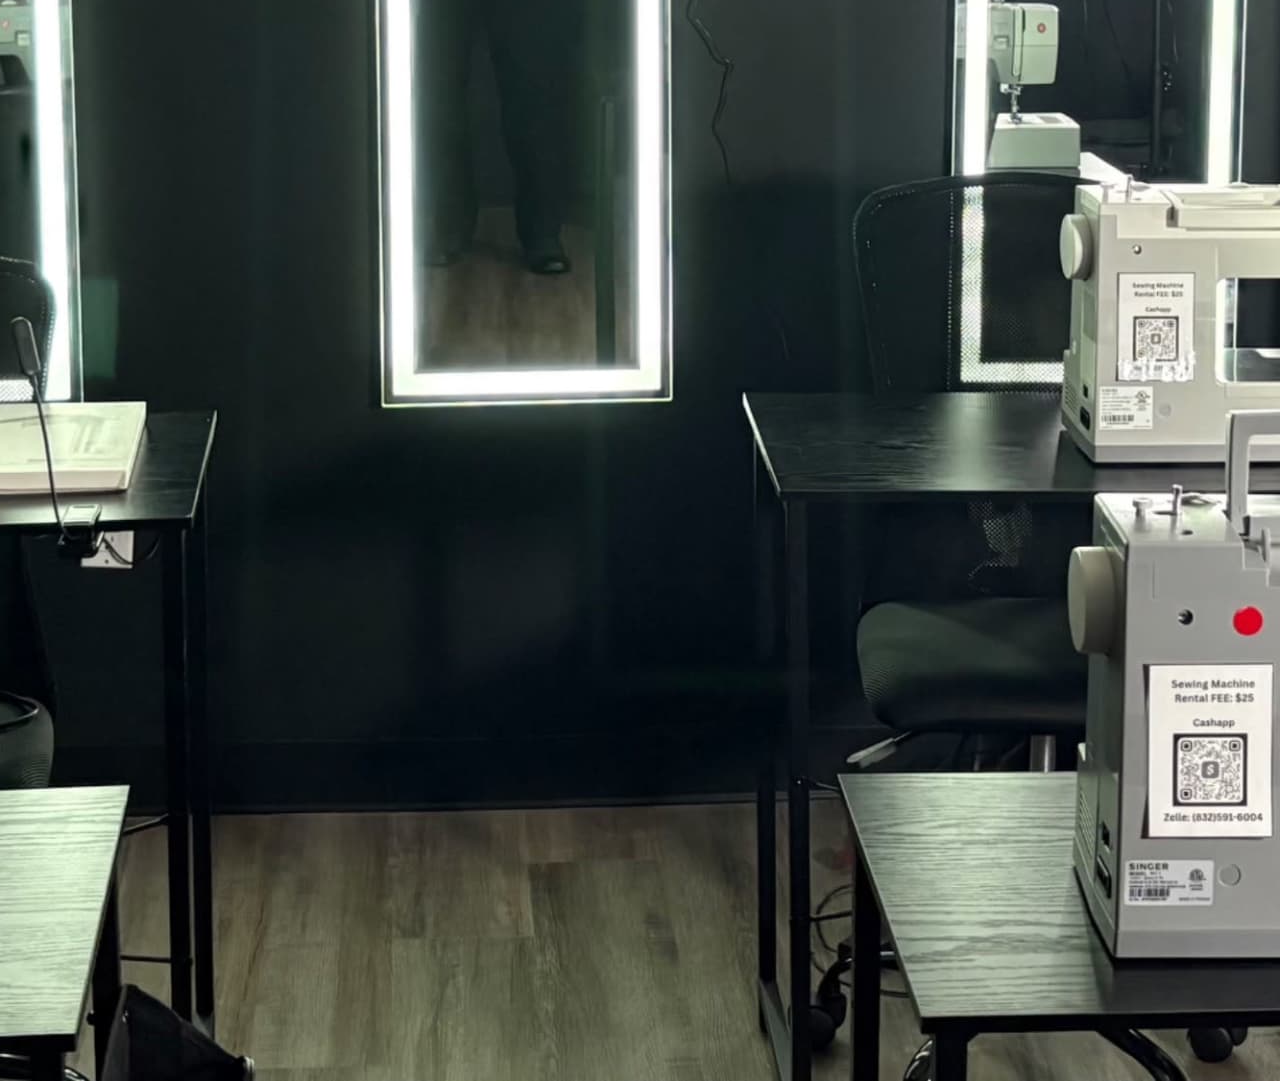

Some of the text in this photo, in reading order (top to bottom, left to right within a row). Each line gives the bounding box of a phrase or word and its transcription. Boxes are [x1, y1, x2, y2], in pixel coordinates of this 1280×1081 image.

[1171, 679, 1256, 690] Sewing Machine
[1175, 692, 1255, 703] Rental FEE: $25
[1192, 718, 1236, 727] Cashapp
[1163, 812, 1264, 823] Zelle: (832)591-6004
[1129, 862, 1169, 871] SINGER
